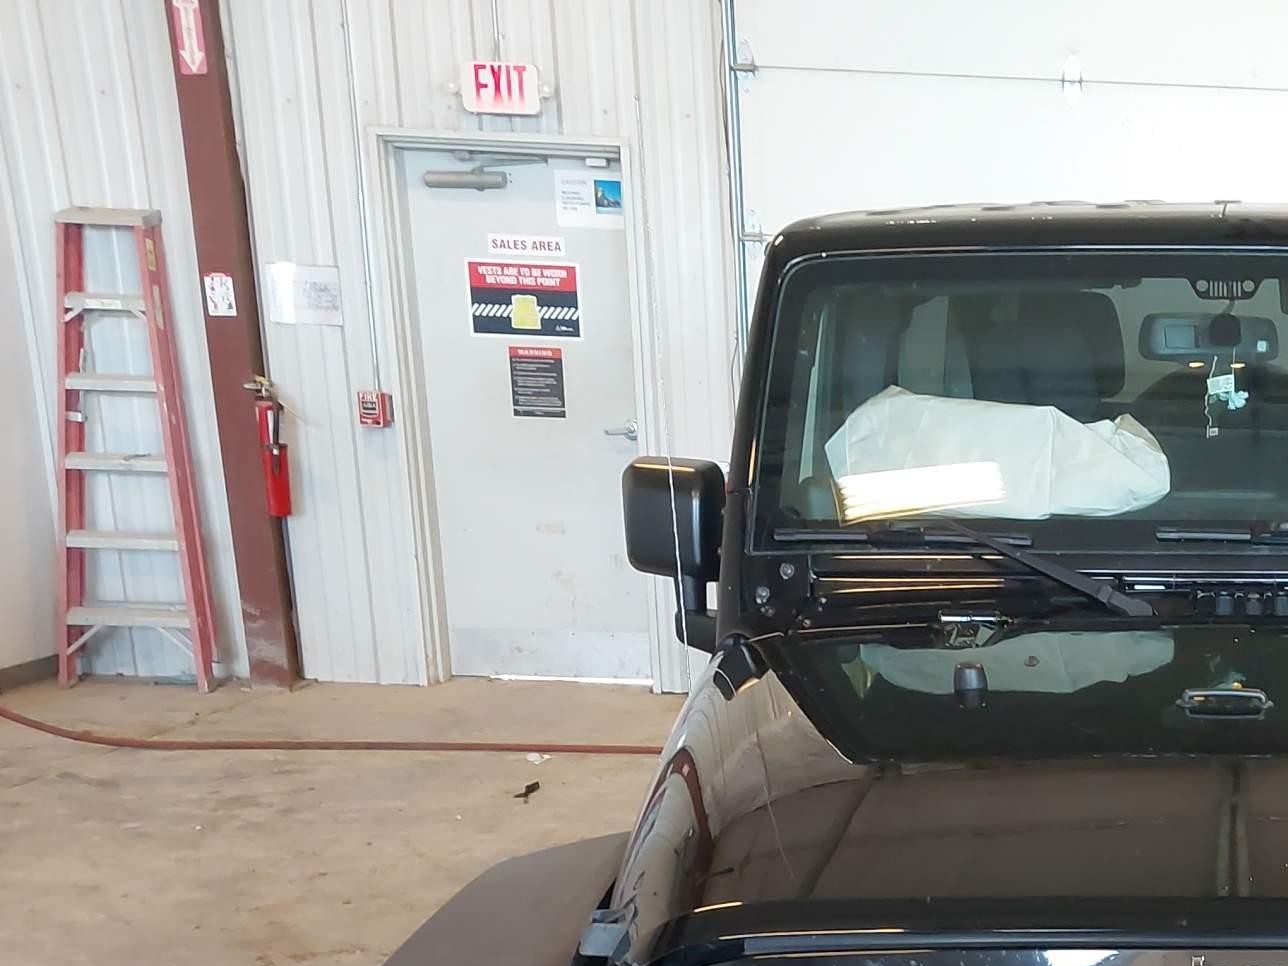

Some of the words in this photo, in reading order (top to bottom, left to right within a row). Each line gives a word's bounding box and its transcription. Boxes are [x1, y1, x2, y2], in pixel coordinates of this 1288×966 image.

[473, 63, 527, 104] EXIT
[491, 238, 527, 250] SALES
[531, 240, 562, 252] AREA
[503, 266, 518, 275] ARE
[520, 267, 530, 276] TO
[486, 274, 518, 284] BEYOND
[519, 276, 536, 285] THIS
[537, 277, 560, 287] POINT
